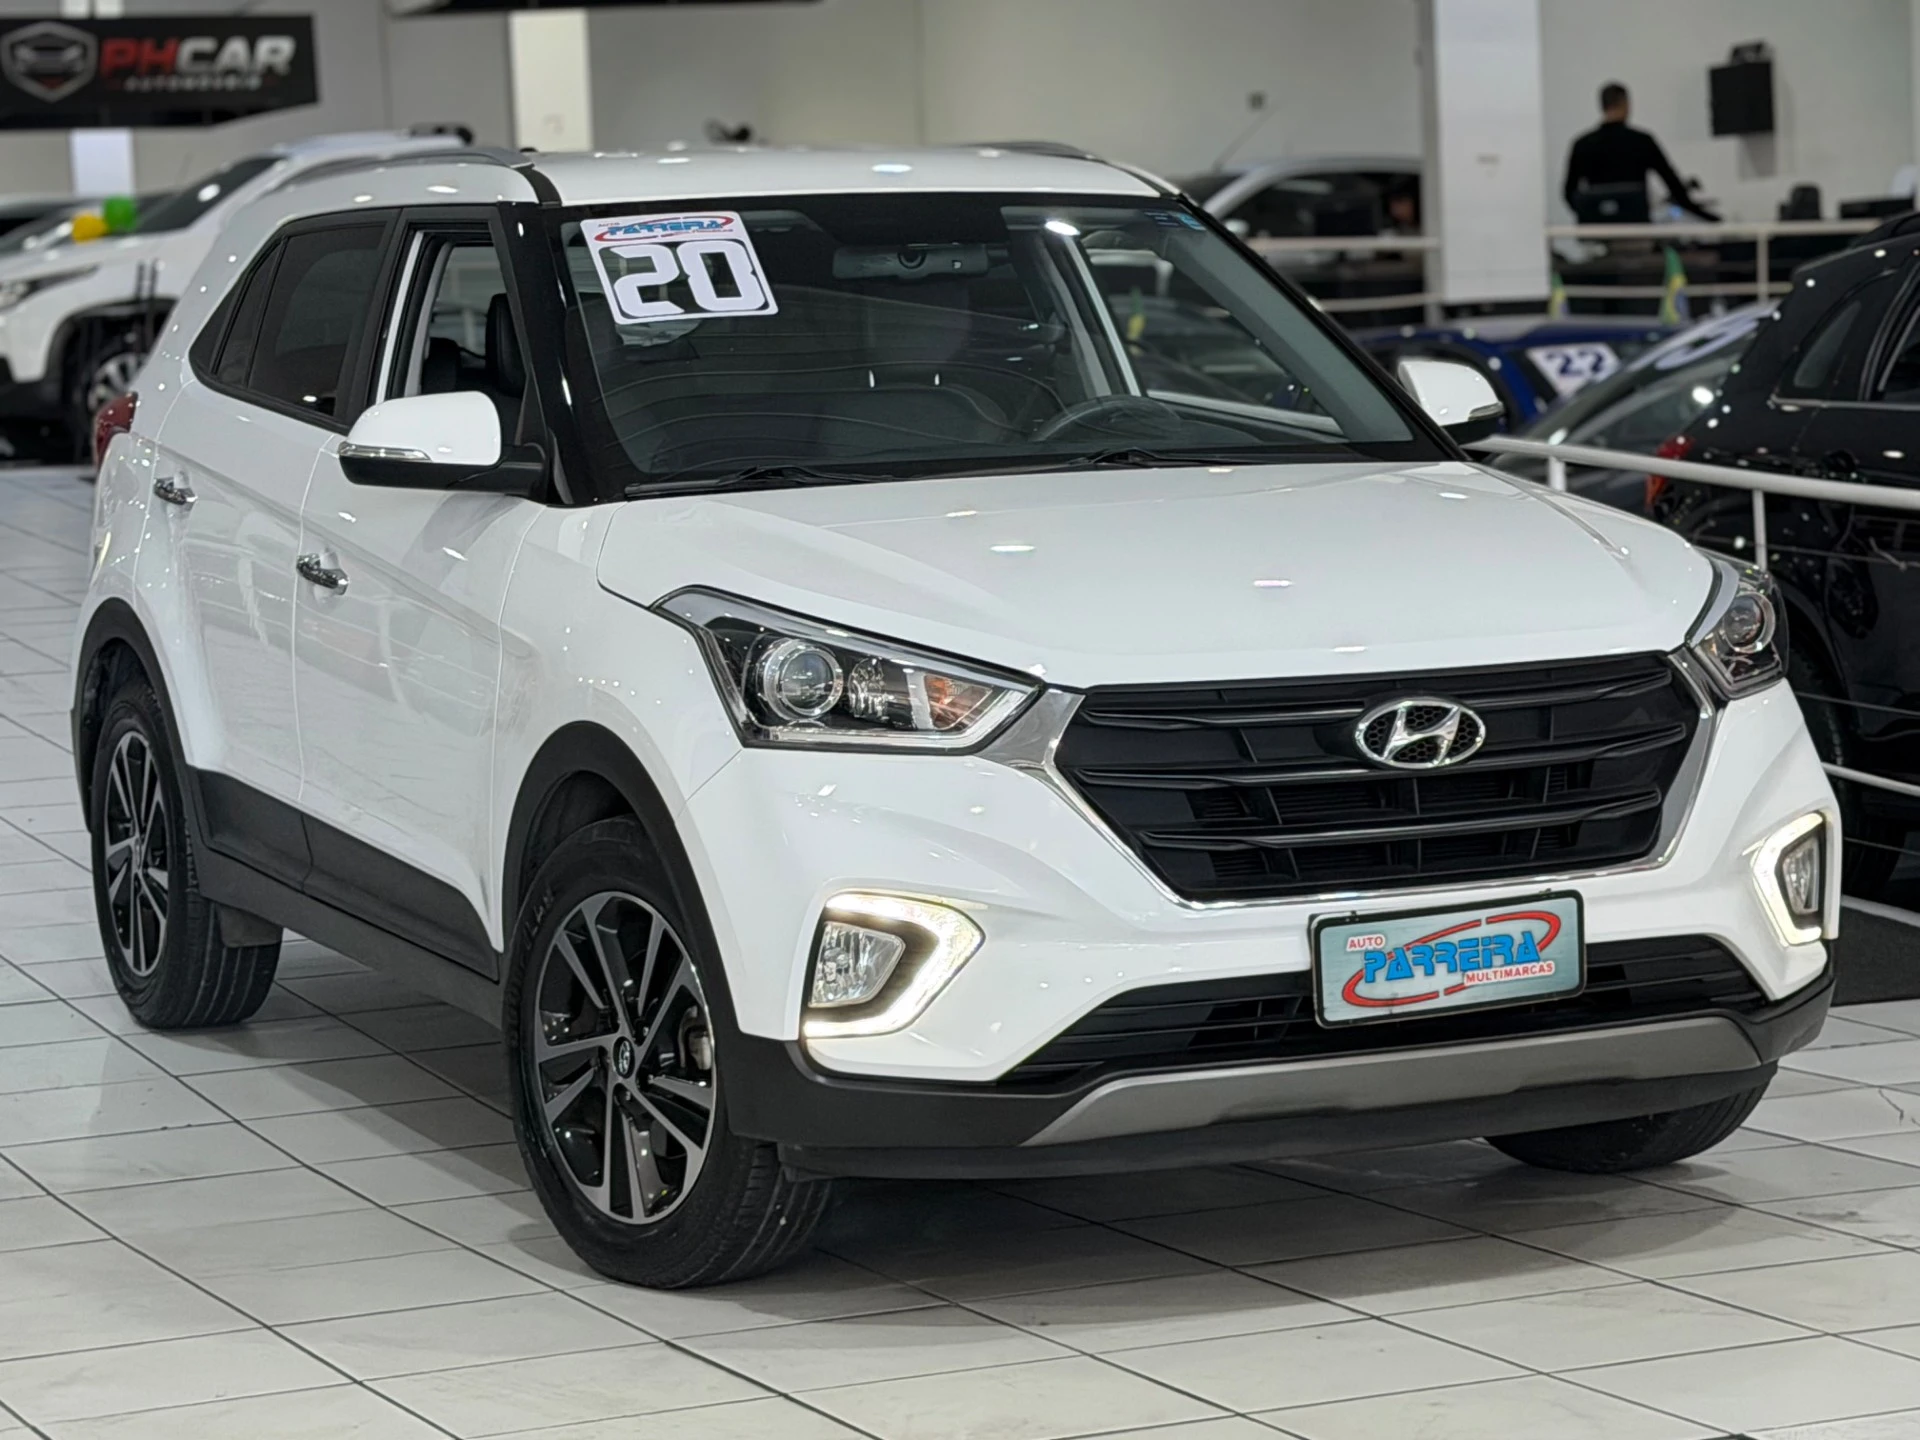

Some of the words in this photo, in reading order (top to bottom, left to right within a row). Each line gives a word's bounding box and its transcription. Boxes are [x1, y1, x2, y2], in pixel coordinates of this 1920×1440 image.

[102, 35, 296, 76] PHCAR
[609, 240, 766, 318] 20
[1348, 935, 1384, 950] AUTO
[1363, 930, 1541, 984] PARREIRA
[1465, 962, 1554, 984] MULTIMARCAS
